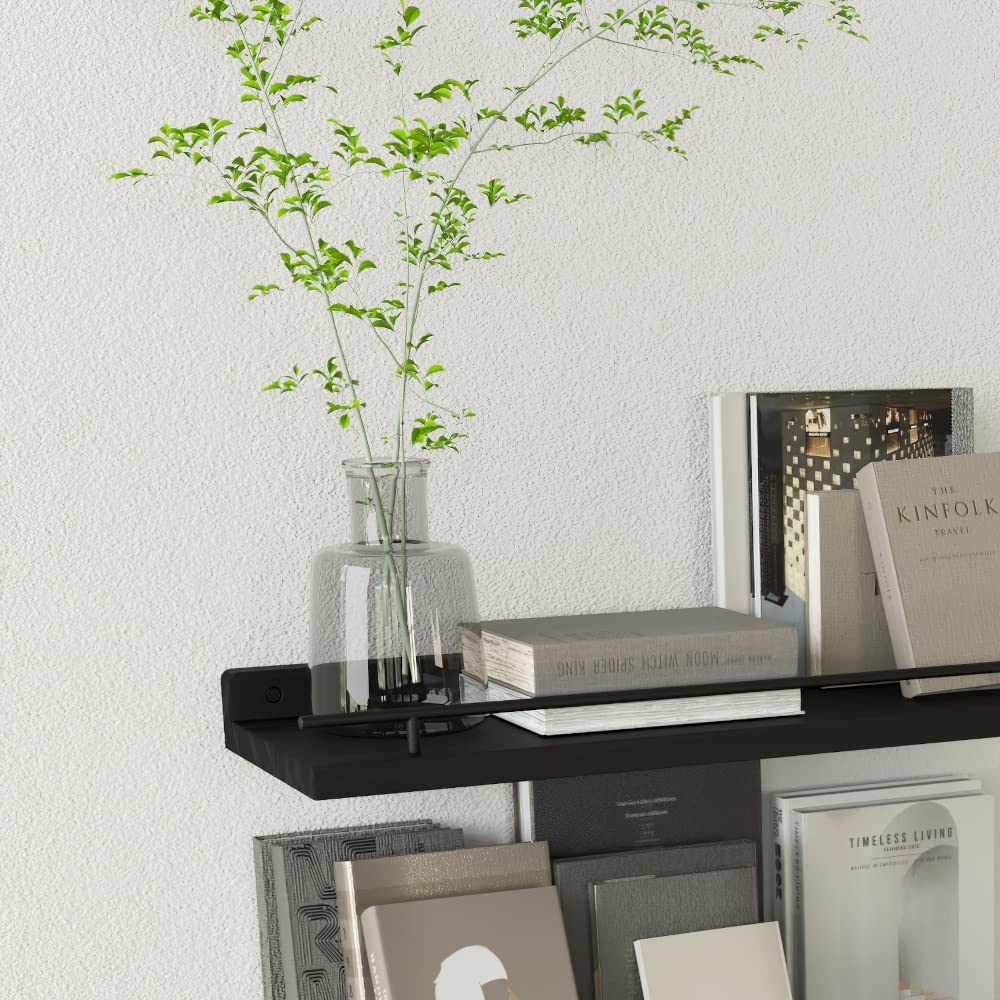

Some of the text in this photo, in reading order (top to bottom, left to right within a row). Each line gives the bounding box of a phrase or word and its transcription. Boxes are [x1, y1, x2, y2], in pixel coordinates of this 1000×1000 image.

[931, 486, 956, 496] THE
[896, 498, 1000, 524] KINFOLK
[934, 525, 970, 537] TRAVEL
[593, 656, 635, 674] SPIDER
[641, 653, 680, 671] WITCH
[686, 650, 720, 667] MOON
[556, 660, 586, 678] KING
[849, 832, 907, 849] TIMELESS
[913, 827, 954, 842] LIVING
